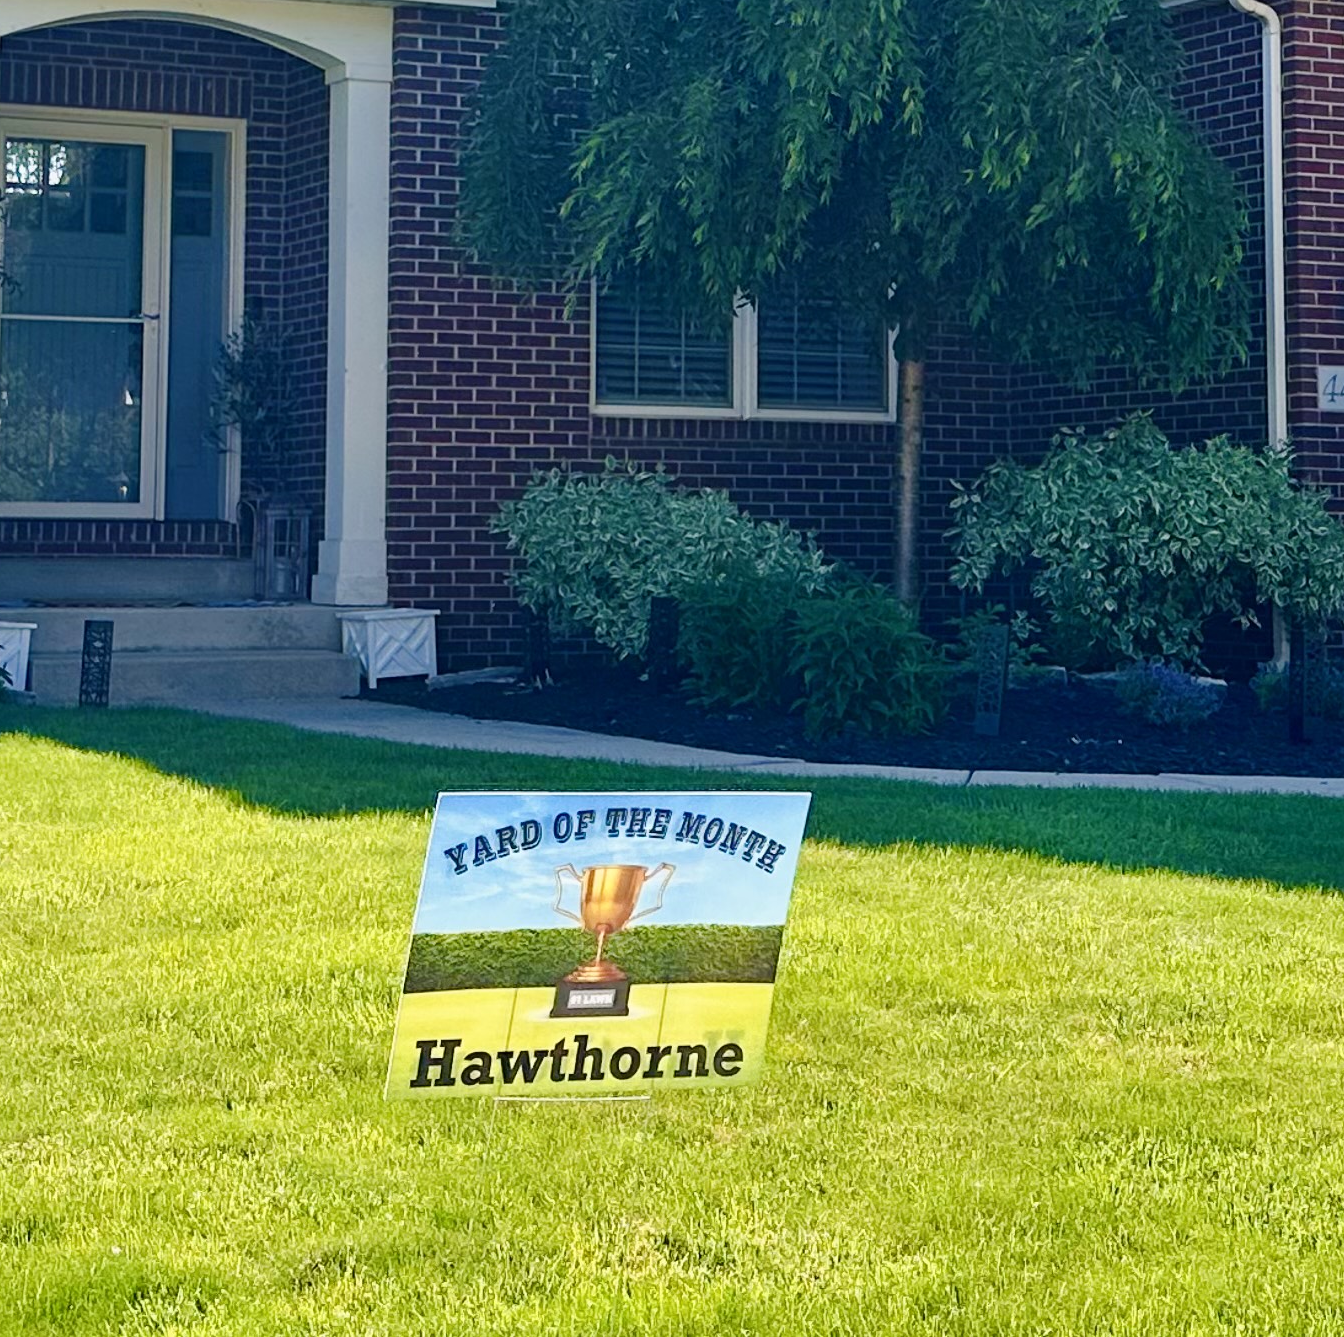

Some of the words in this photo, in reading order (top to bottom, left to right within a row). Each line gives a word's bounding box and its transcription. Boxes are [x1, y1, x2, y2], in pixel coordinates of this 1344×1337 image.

[444, 819, 542, 875] YARD
[552, 809, 596, 842] OF
[605, 807, 672, 839] THE
[674, 811, 787, 874] MONTH
[409, 1035, 744, 1088] Hawthorne
